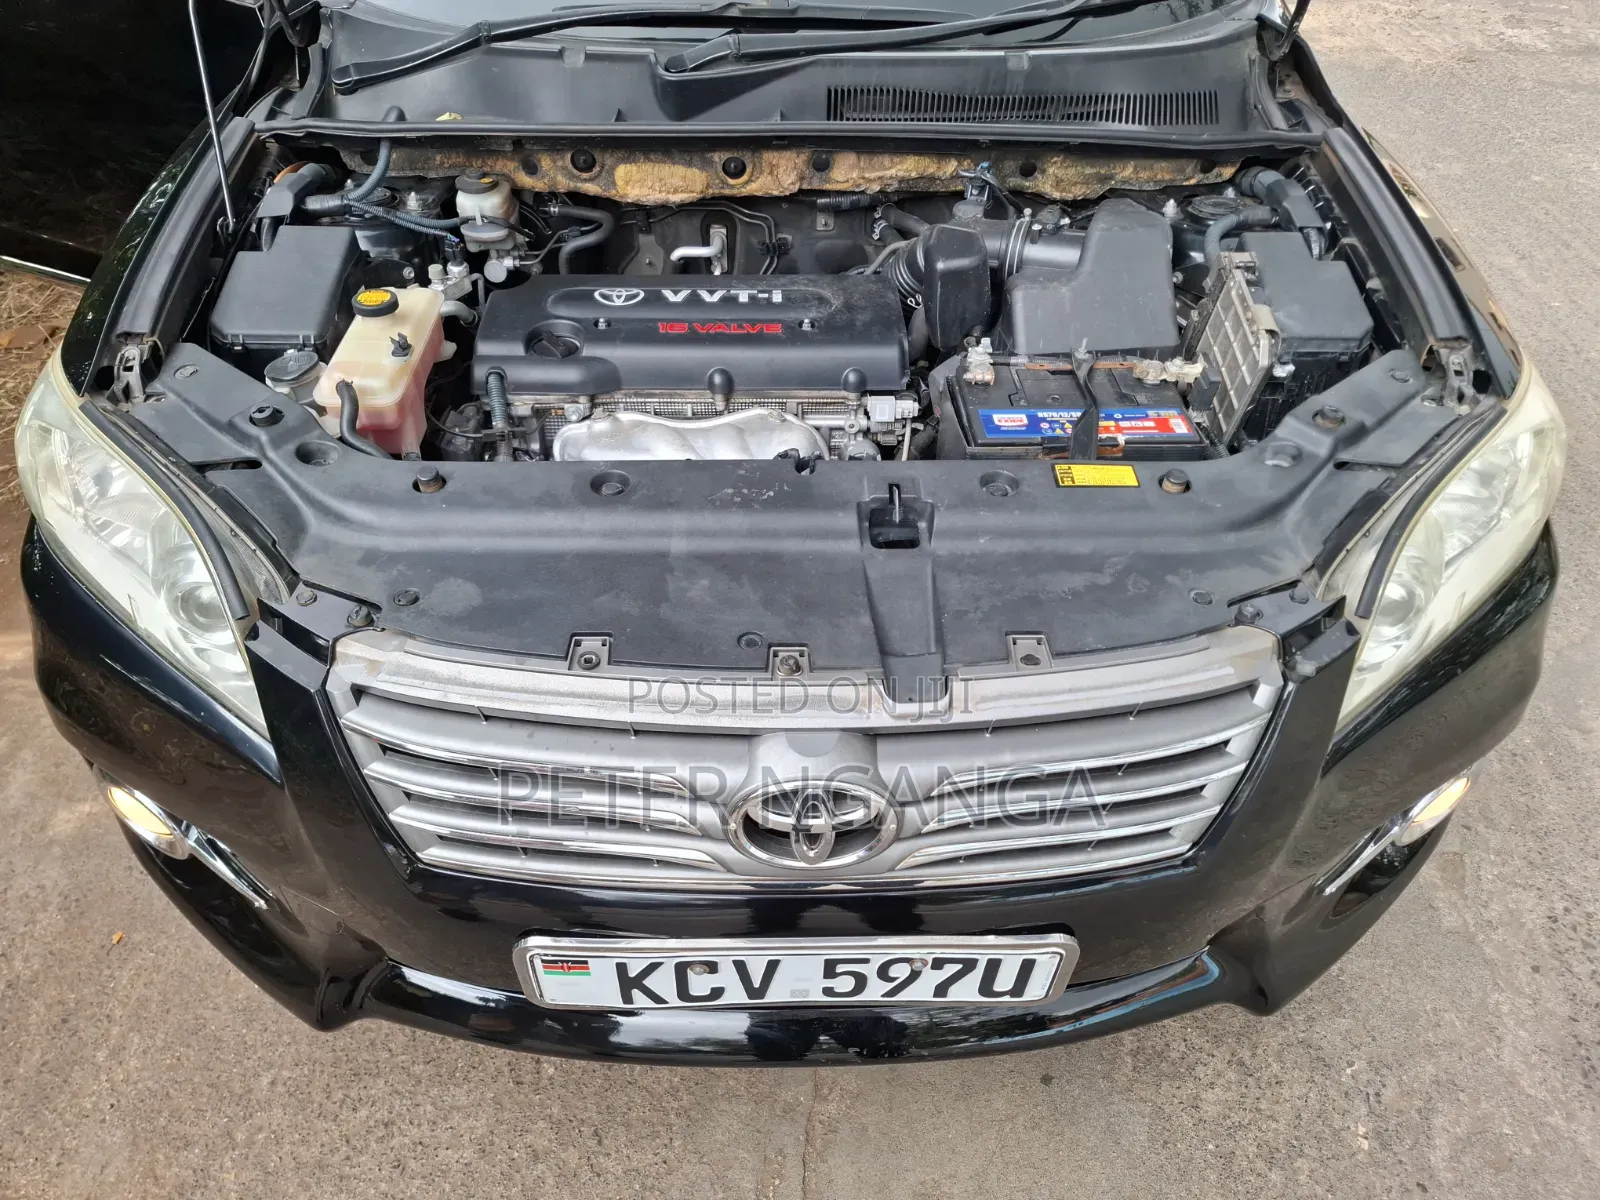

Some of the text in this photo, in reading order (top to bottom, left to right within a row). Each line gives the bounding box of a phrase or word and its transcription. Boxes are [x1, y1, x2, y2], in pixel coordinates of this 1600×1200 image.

[658, 322, 782, 333] 16 VALVE
[615, 957, 783, 1006] KCV
[821, 956, 1036, 1000] 597U
